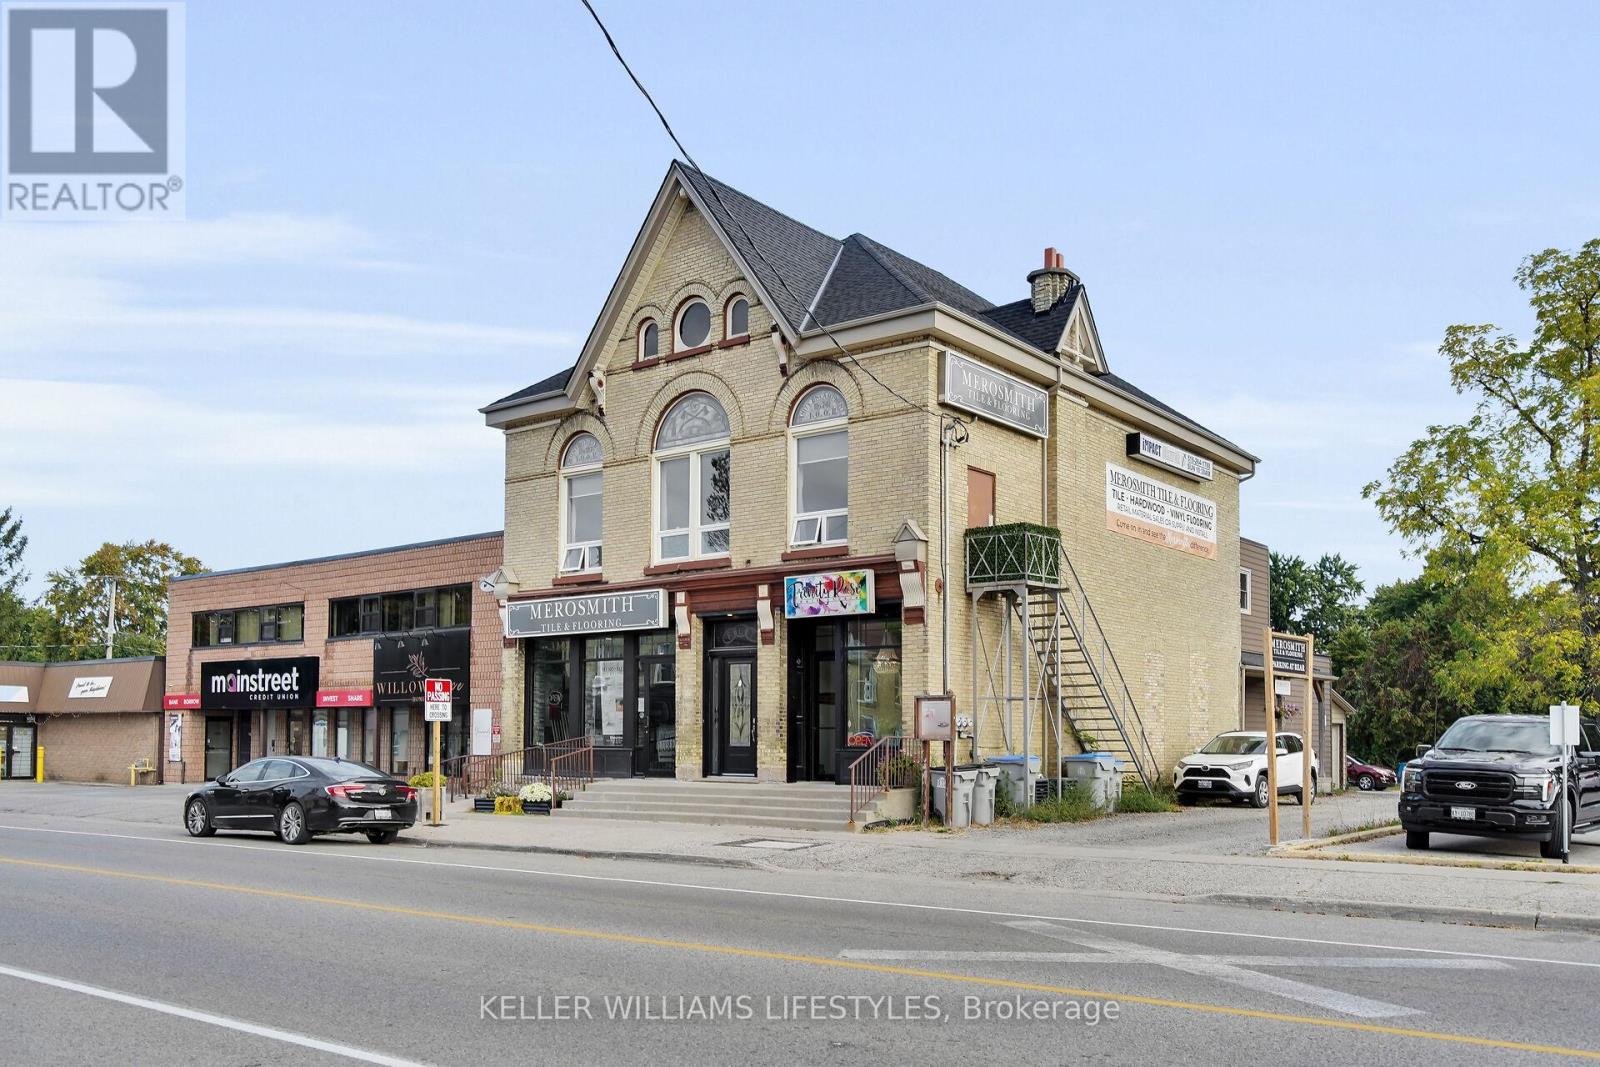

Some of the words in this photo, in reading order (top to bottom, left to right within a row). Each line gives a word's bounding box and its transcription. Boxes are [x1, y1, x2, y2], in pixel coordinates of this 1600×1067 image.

[962, 369, 1036, 412] MEROSMITH
[968, 388, 986, 405] TILE
[994, 400, 1031, 420] FLOORING
[1110, 469, 1156, 498] MEROSMITH
[1157, 487, 1173, 504] TILE
[1174, 493, 1180, 506] &
[1180, 495, 1214, 518] FLOORING
[1112, 488, 1125, 502] TILE
[1130, 495, 1165, 515] HARDWOOD
[1169, 509, 1186, 522] VINYL
[1186, 514, 1213, 531] FLOORING
[529, 596, 634, 620] MEROSMITH
[540, 622, 563, 633] TILE
[563, 622, 572, 632] &
[572, 618, 622, 631] FLOORING
[211, 667, 300, 693] mainstreet
[434, 682, 443, 692] NO
[322, 695, 339, 703] INVEST
[347, 694, 363, 702] SHARE
[427, 691, 450, 702] PASSING
[429, 711, 448, 719] CROSSING
[848, 735, 873, 747] OPEN
